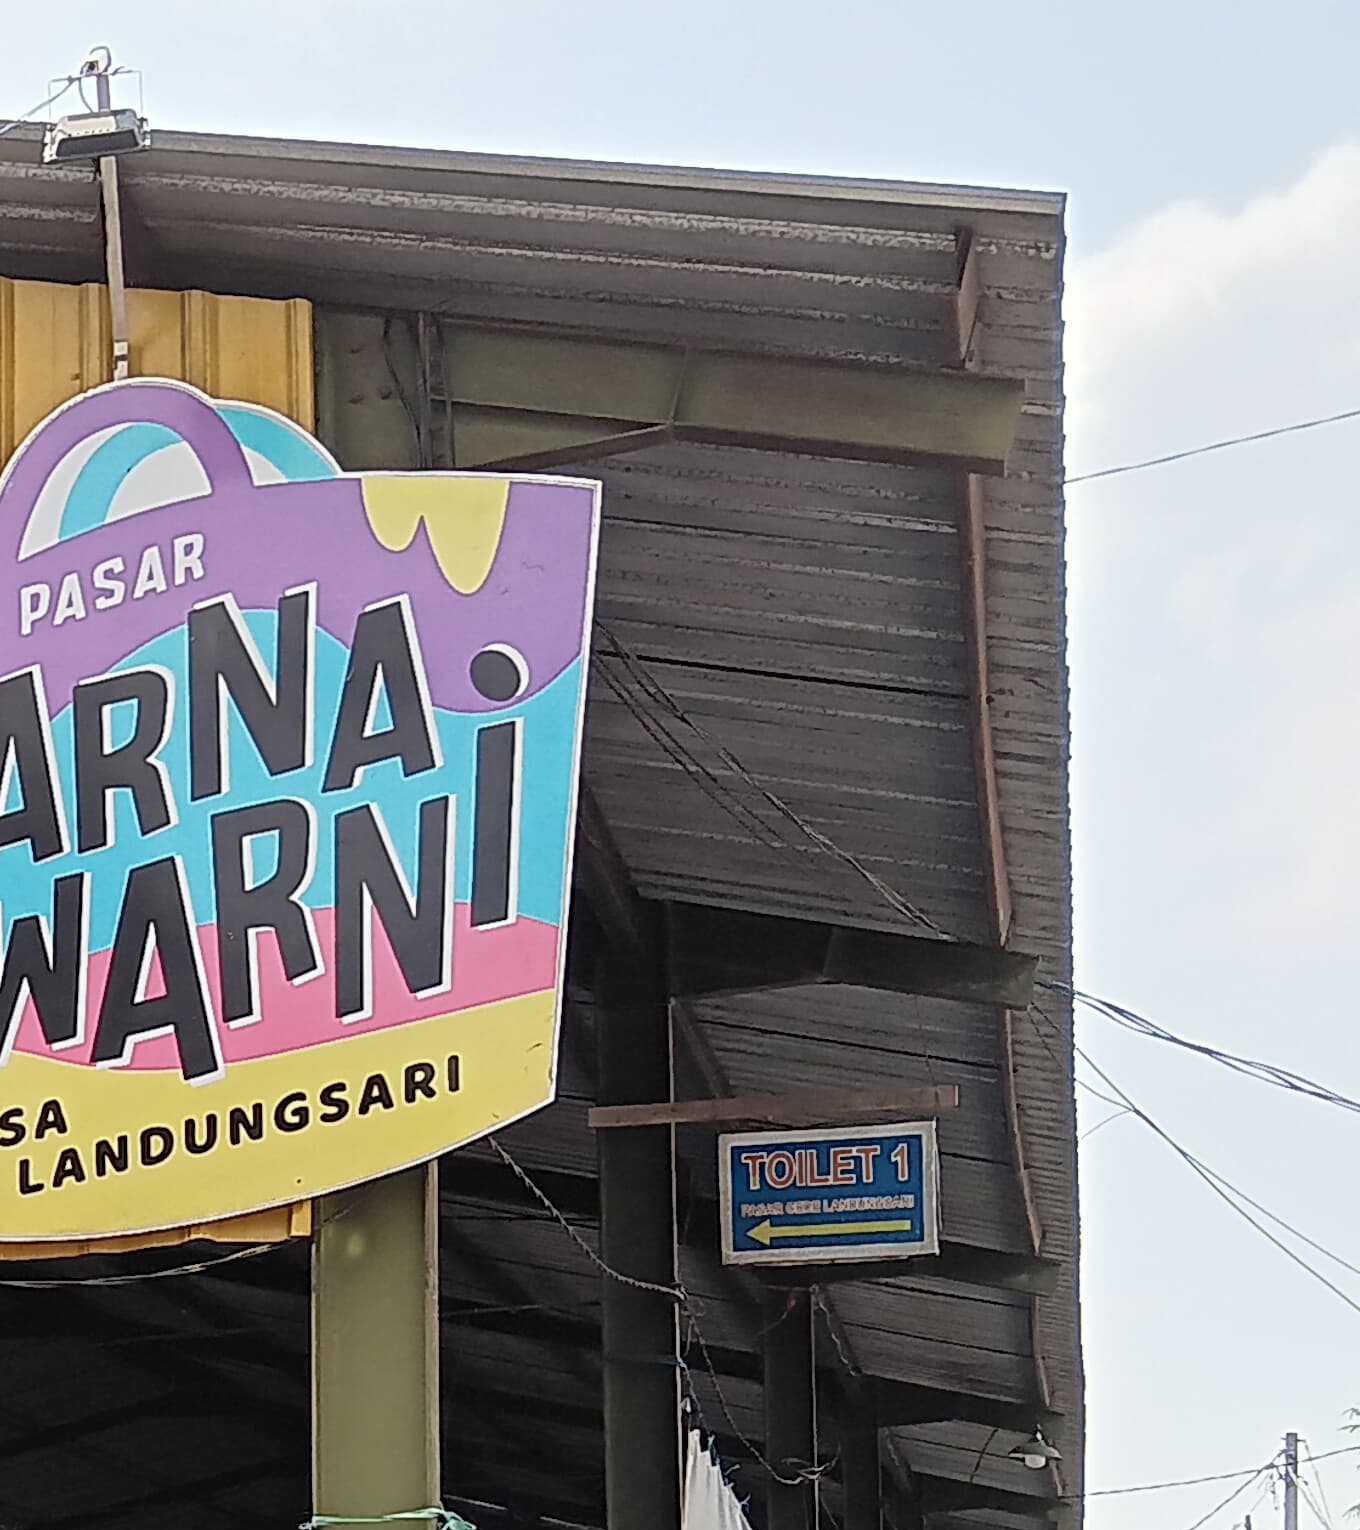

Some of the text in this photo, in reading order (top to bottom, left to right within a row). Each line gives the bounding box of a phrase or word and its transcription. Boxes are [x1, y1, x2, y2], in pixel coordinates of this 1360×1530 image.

[19, 534, 207, 638] PASAR
[18, 1054, 464, 1197] LANDUNGSARI
[742, 1143, 909, 1190] TOILET 1
